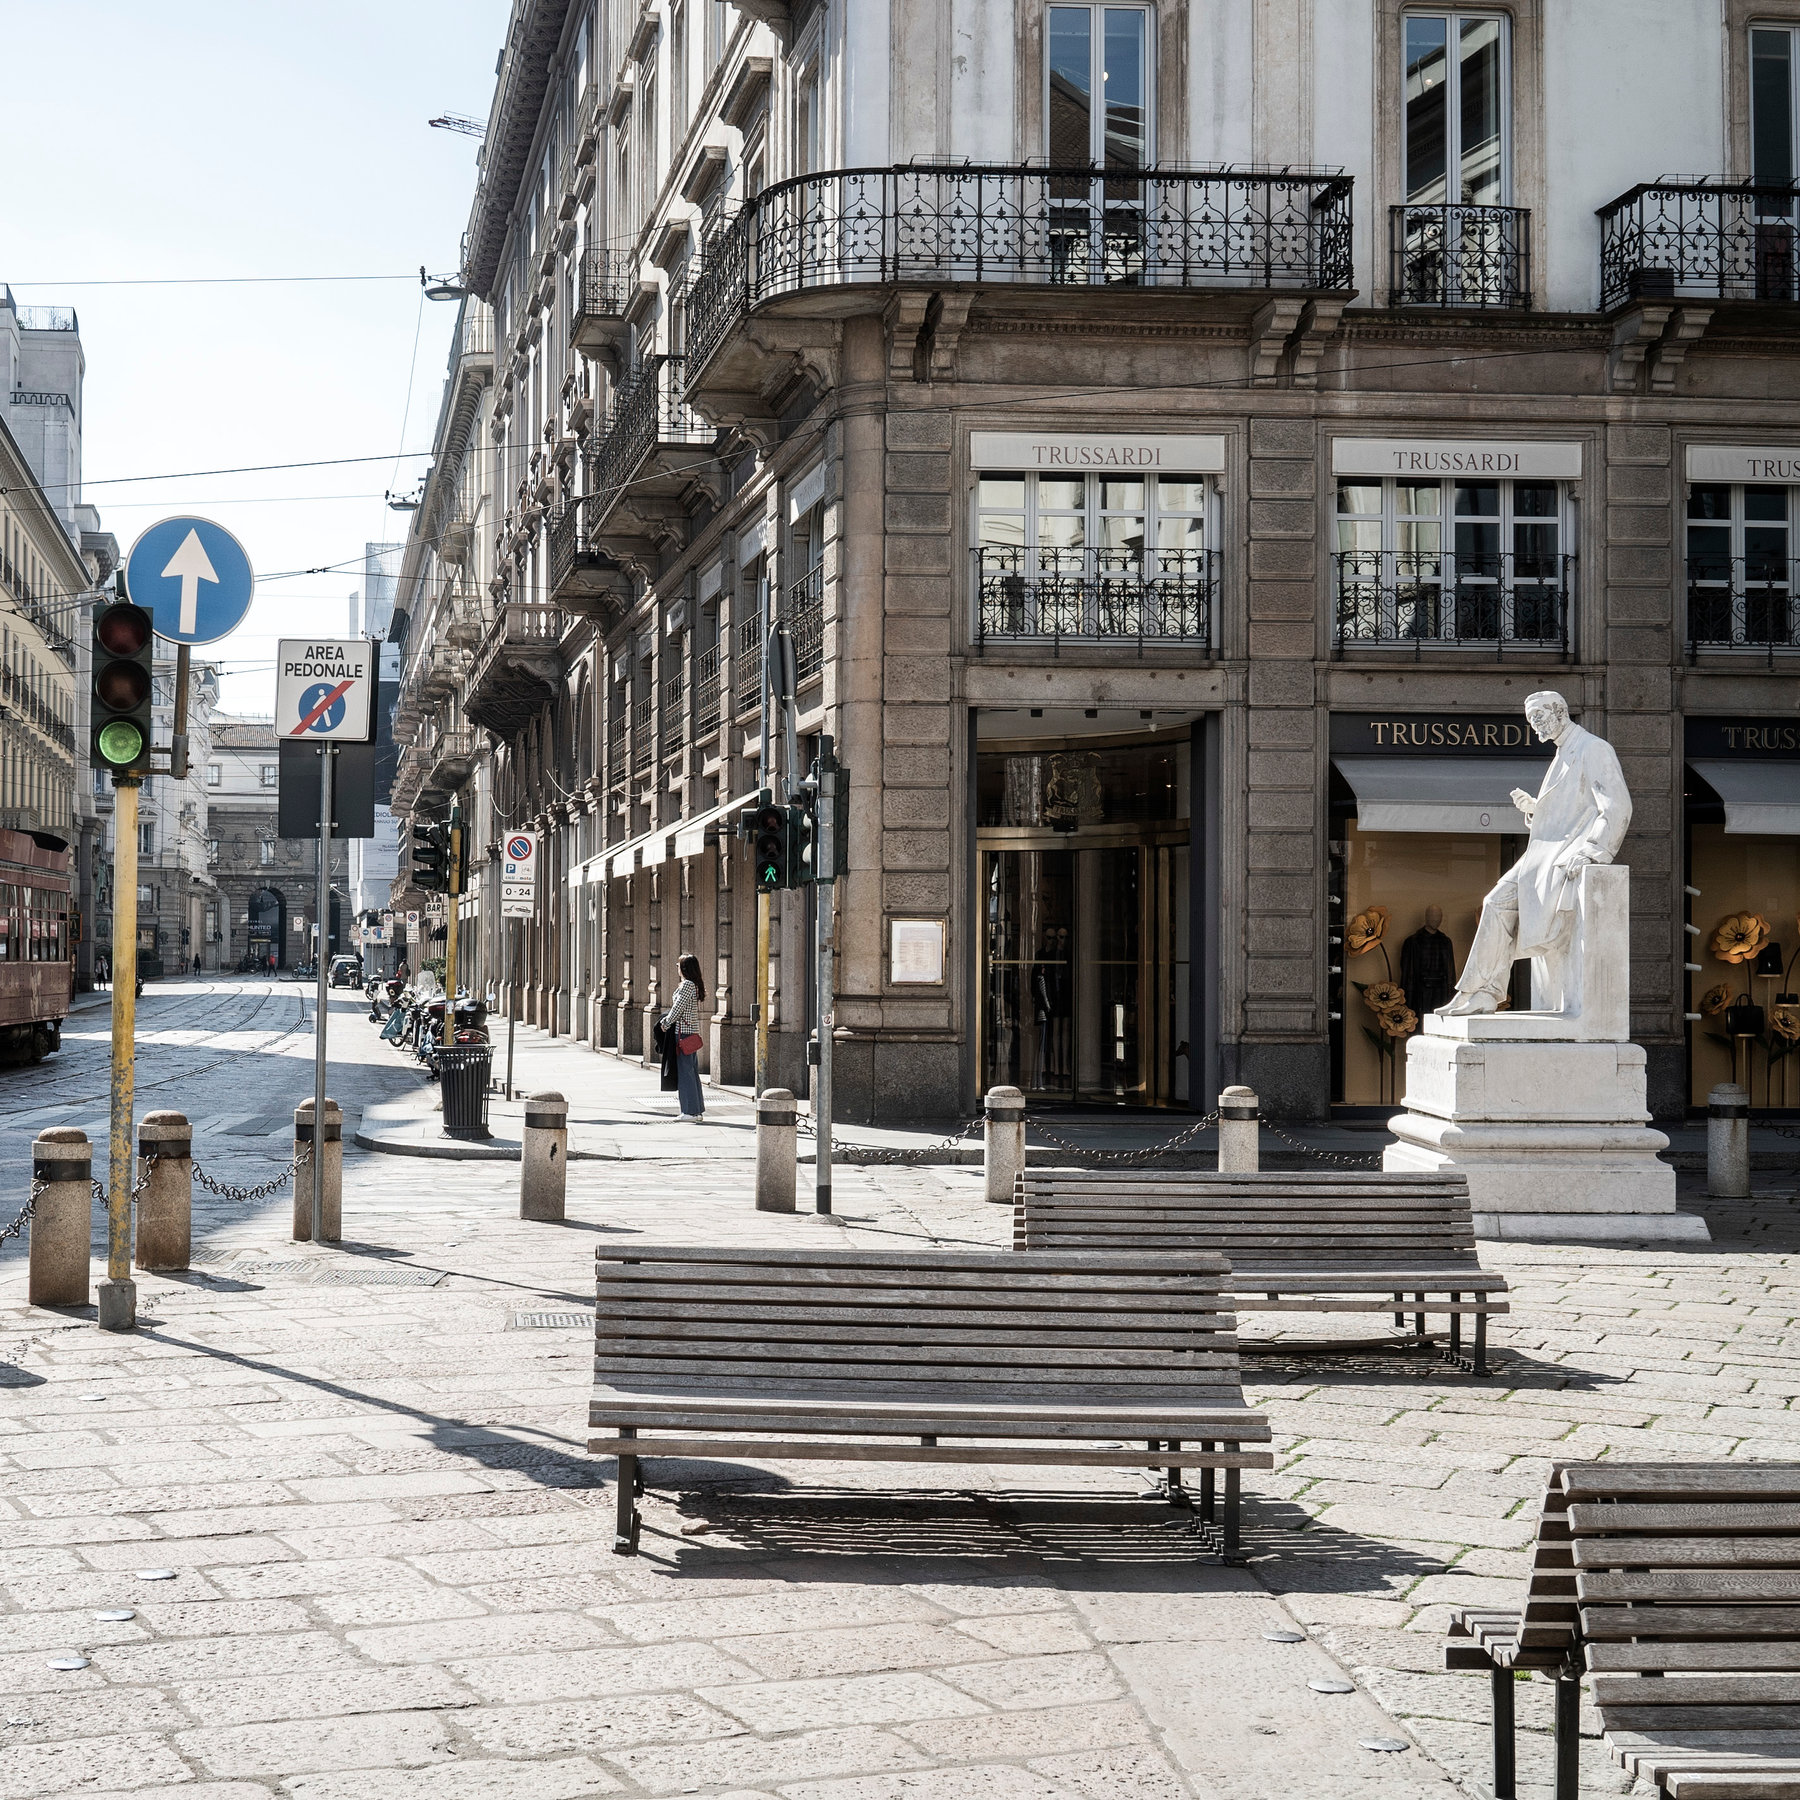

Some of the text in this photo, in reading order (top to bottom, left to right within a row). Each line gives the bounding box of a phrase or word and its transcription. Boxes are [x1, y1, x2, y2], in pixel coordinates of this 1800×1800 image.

[1032, 445, 1162, 466] TRUSSARDI
[1392, 451, 1520, 472] TRUSSARDI
[304, 645, 345, 661] AREA
[284, 662, 363, 678] PEDONALE
[1370, 722, 1533, 747] TRUSSARDI
[1722, 726, 1800, 750] TRUS
[426, 903, 441, 912] BAR
